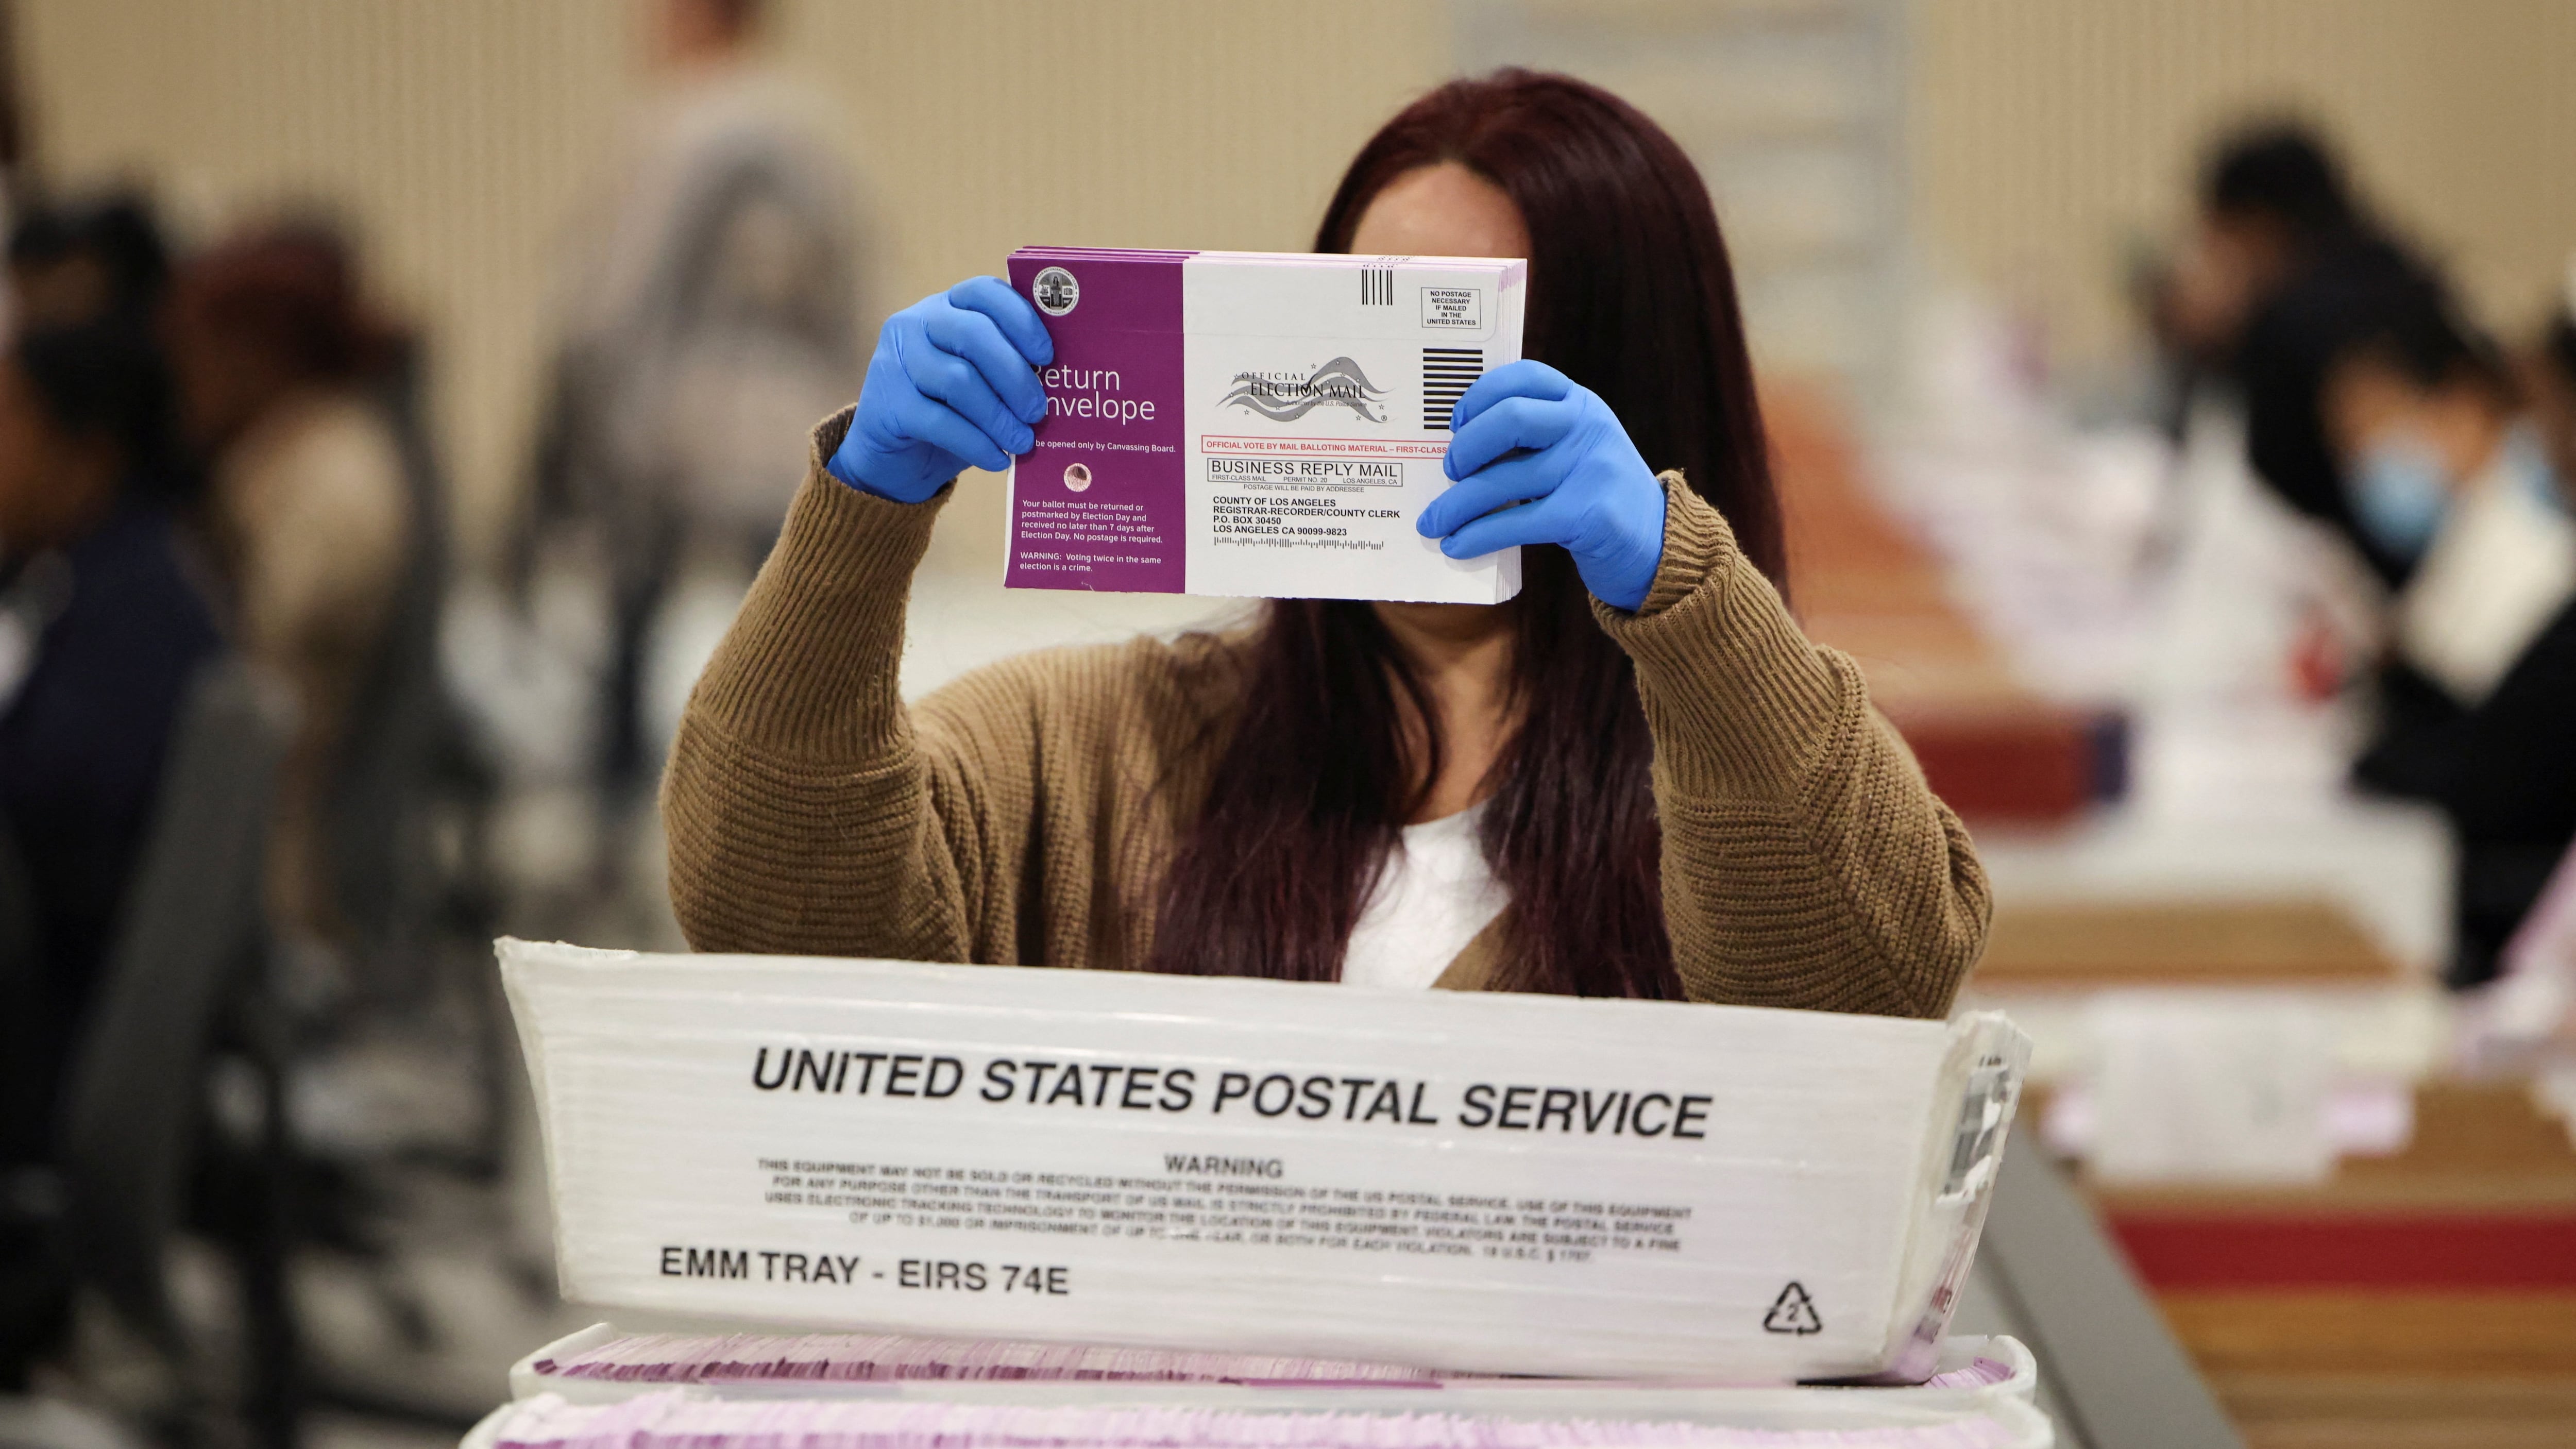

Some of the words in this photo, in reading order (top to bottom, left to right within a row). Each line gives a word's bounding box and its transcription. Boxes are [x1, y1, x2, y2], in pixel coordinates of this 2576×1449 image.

[1242, 372, 1306, 380] OFFICIAL
[1251, 382, 1324, 397] ELECTION
[1329, 384, 1366, 398] MAIL
[1046, 391, 1155, 426] nvelope
[1047, 441, 1075, 449] opened
[1078, 442, 1094, 450] only
[1096, 442, 1105, 451] by
[1107, 442, 1149, 453] Canvassing
[1396, 446, 1447, 454] FIRST-CLASS
[1212, 460, 1294, 475] BUSINESS
[1301, 463, 1353, 476] REPLY
[1360, 464, 1398, 477] MAIL
[1213, 496, 1251, 504] COUNTY
[1291, 498, 1335, 507] ANGELES
[1022, 511, 1068, 519] postmarked
[1071, 511, 1080, 521] by
[1083, 512, 1113, 520] Election
[1116, 513, 1130, 523] Day
[1214, 507, 1365, 517] REGISTRAR-RECORDER/COUNTY
[1368, 510, 1400, 518] CLERK
[1117, 524, 1134, 533] days
[1234, 526, 1279, 534] ANGELES
[1297, 527, 1347, 536] 90099-9823
[1022, 531, 1052, 539] Election
[1055, 532, 1071, 542] Day.
[1087, 534, 1118, 543] postage
[1129, 535, 1162, 544] required.
[1021, 552, 1061, 560] WARNING:
[1066, 553, 1091, 563] Voting
[1020, 562, 1051, 570] election
[753, 1047, 964, 1099] UNITED
[980, 1059, 1195, 1113] STATES
[1213, 1072, 1437, 1125] POSTAL
[1459, 1084, 1713, 1139] SERVICE
[1165, 1155, 1282, 1178] WARNING
[661, 1246, 748, 1279] EMM
[759, 1252, 859, 1284] TRAY
[899, 1259, 987, 1291] EIRS
[1002, 1265, 1068, 1295] 74E
[1788, 1302, 1799, 1322] 2
